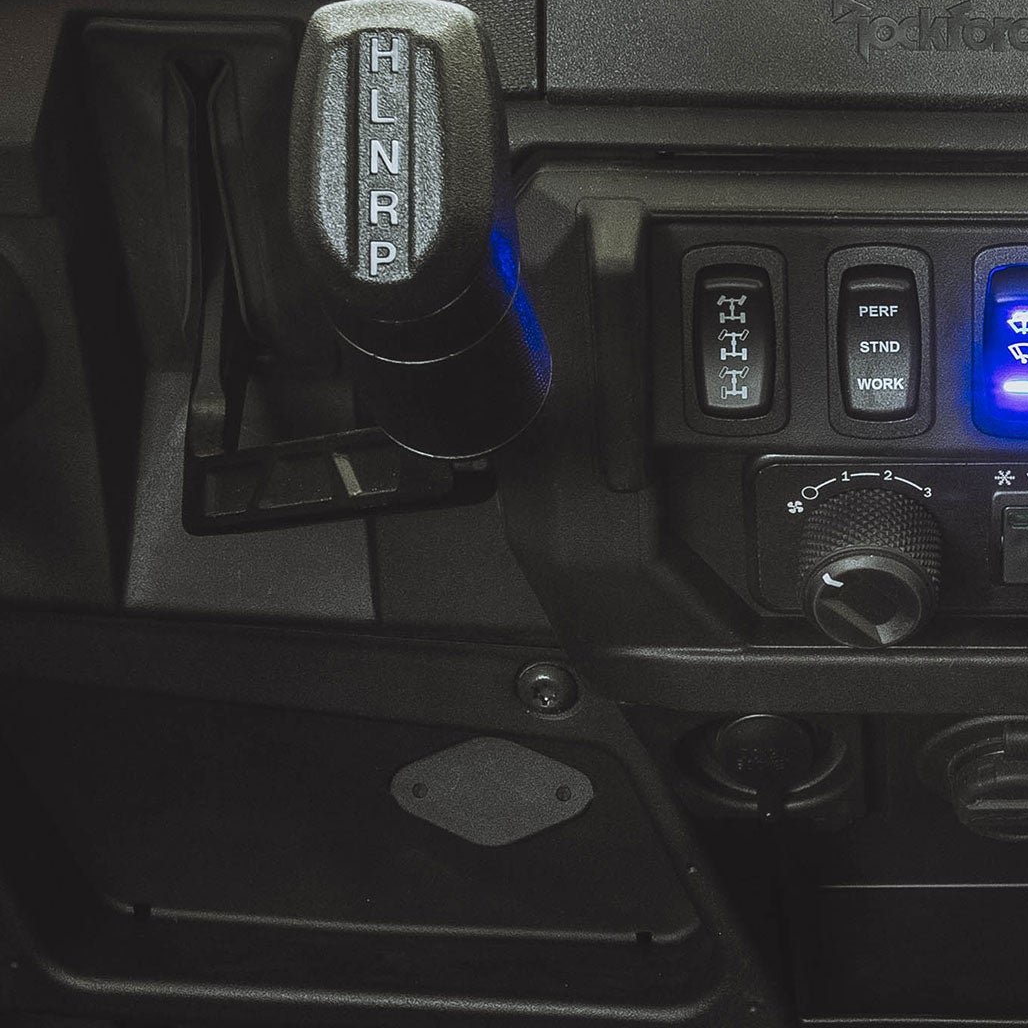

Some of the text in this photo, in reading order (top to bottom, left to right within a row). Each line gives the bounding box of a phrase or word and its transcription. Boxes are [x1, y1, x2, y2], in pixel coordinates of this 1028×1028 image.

[858, 304, 899, 318] PERF
[859, 340, 900, 354] STND
[857, 377, 905, 391] WORK
[841, 469, 933, 499] 1 2 3
